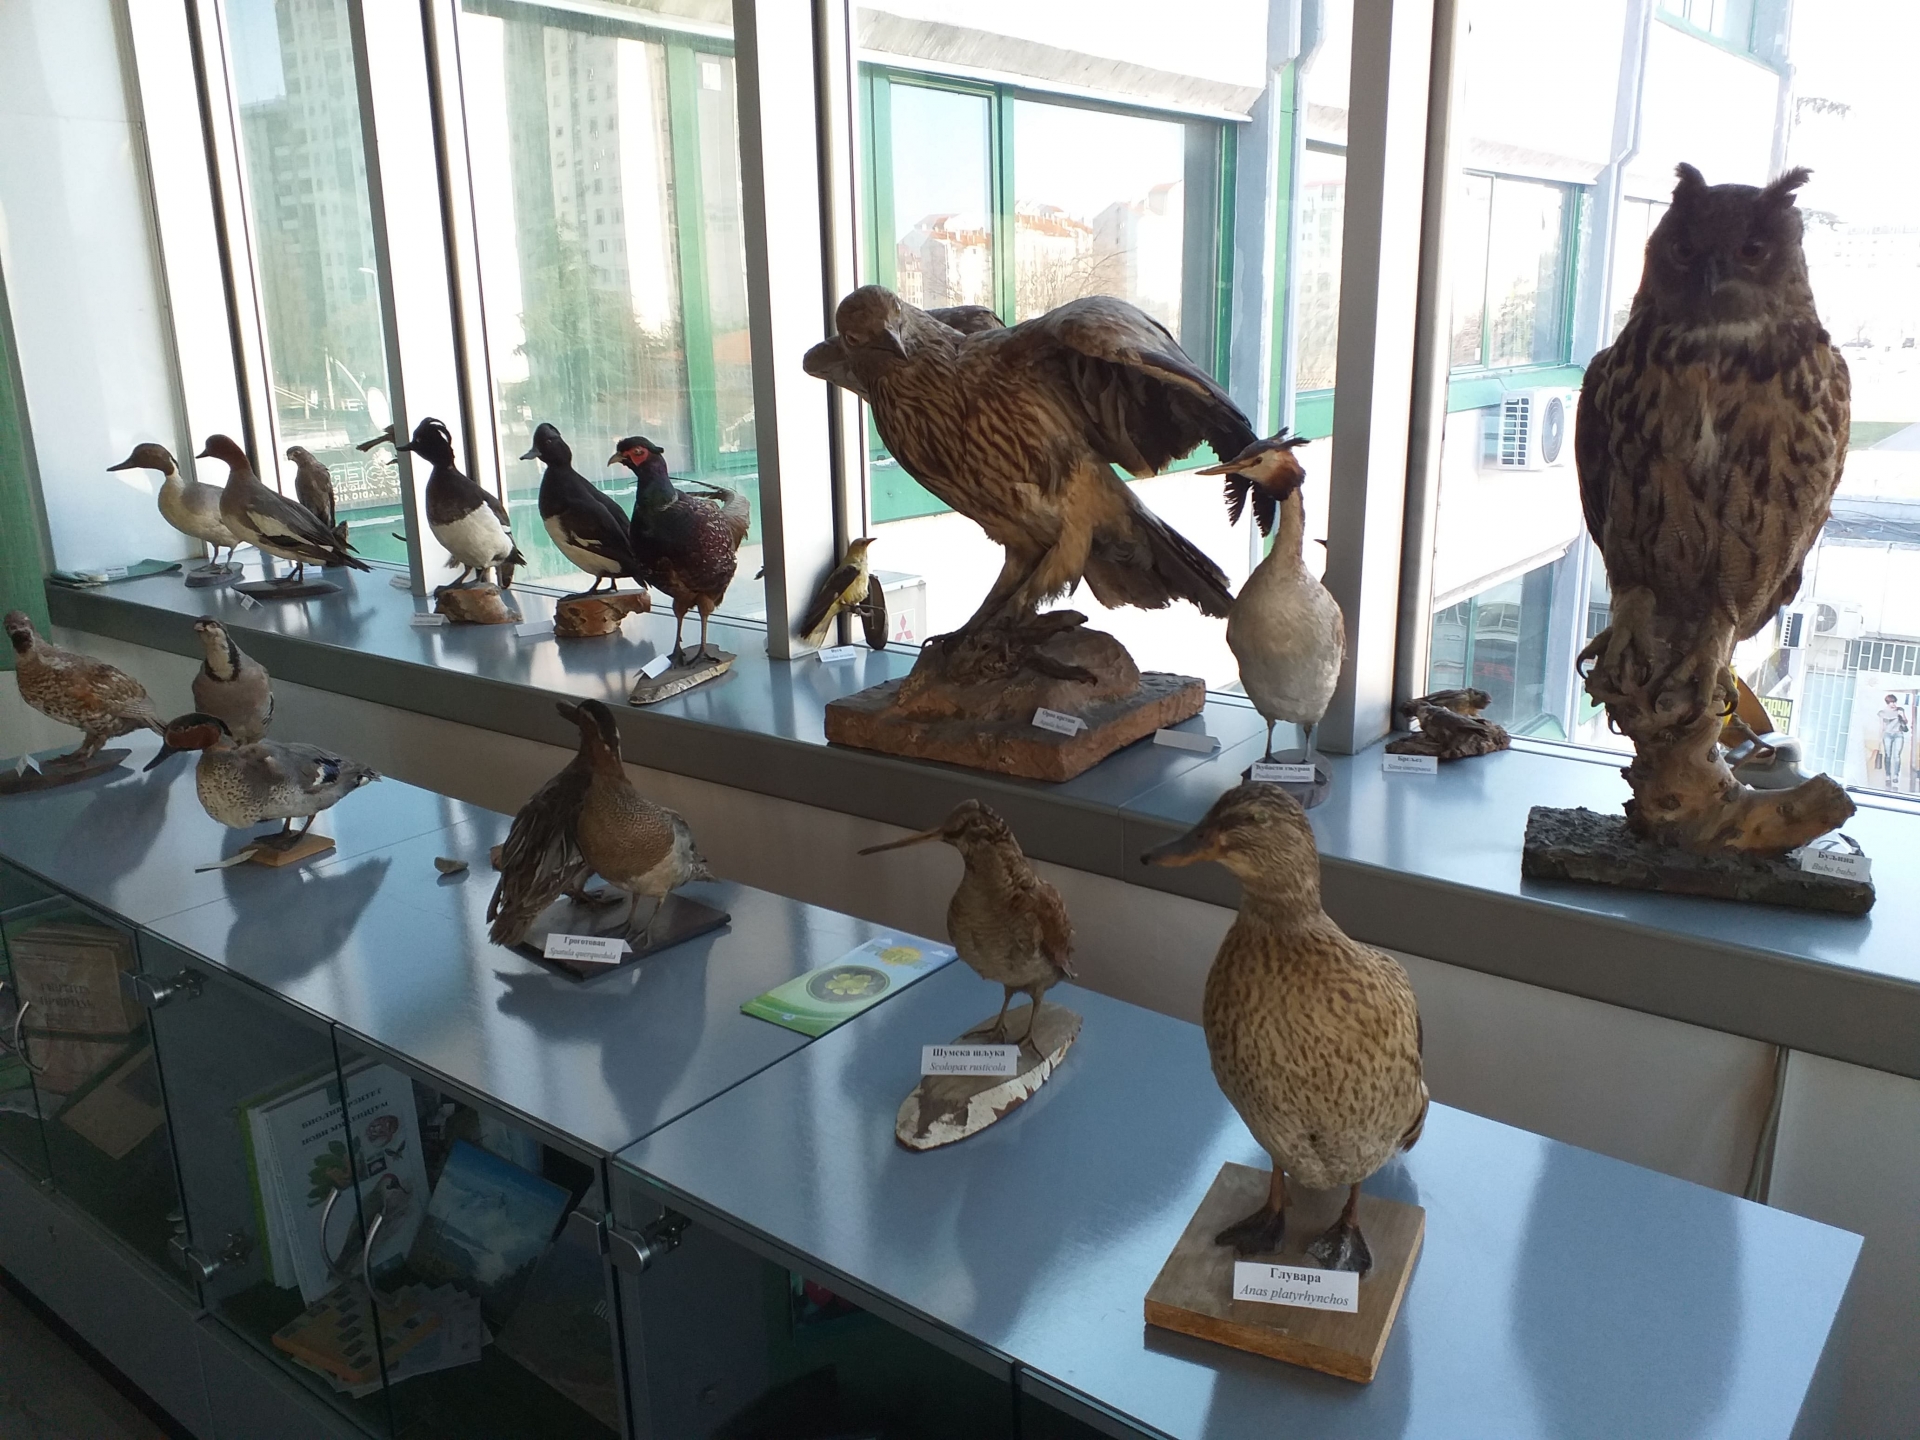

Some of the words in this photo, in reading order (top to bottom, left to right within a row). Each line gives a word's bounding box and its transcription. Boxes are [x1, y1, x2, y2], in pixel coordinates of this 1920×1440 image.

[1818, 850, 1855, 864] Буљина
[1811, 862, 1834, 873] Bubo
[1835, 866, 1857, 877] bubo
[932, 1047, 970, 1058] Шумска
[973, 1049, 1006, 1059] шљука
[929, 1061, 968, 1073] Scolopax
[969, 1062, 1007, 1072] rusticola
[1269, 1267, 1322, 1285] Глувара
[1239, 1284, 1269, 1297] Anas
[1269, 1287, 1350, 1307] platyrhynchos
